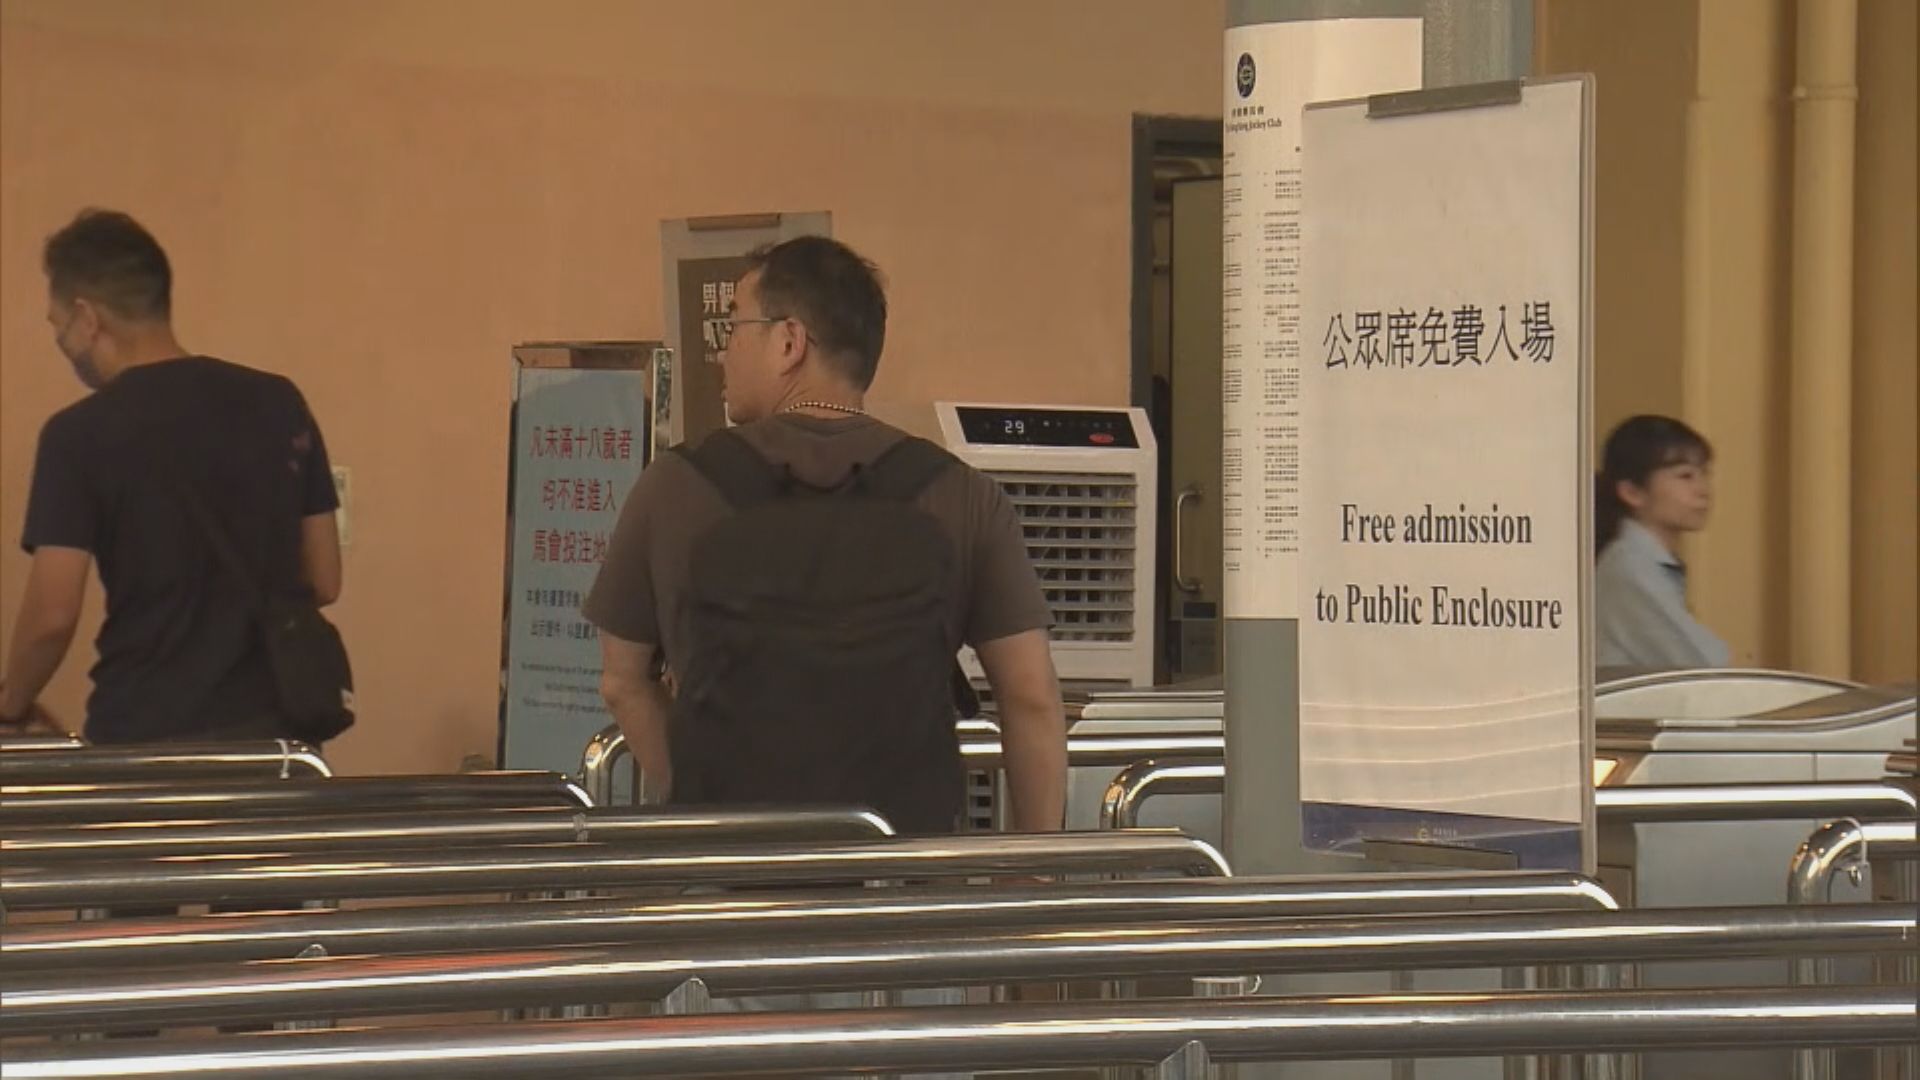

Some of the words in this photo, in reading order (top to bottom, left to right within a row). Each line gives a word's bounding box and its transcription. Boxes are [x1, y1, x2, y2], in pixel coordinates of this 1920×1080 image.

[1267, 118, 1282, 127] Club
[1323, 301, 1554, 370] 公眾席免費入場
[530, 425, 633, 460] 凡未滿十八歲者
[1005, 420, 1025, 434] 29
[1341, 503, 1396, 543] Free
[1403, 503, 1533, 544] admission
[1315, 586, 1339, 623] to
[1345, 583, 1423, 626] Public
[1431, 586, 1562, 630] Enclosure
